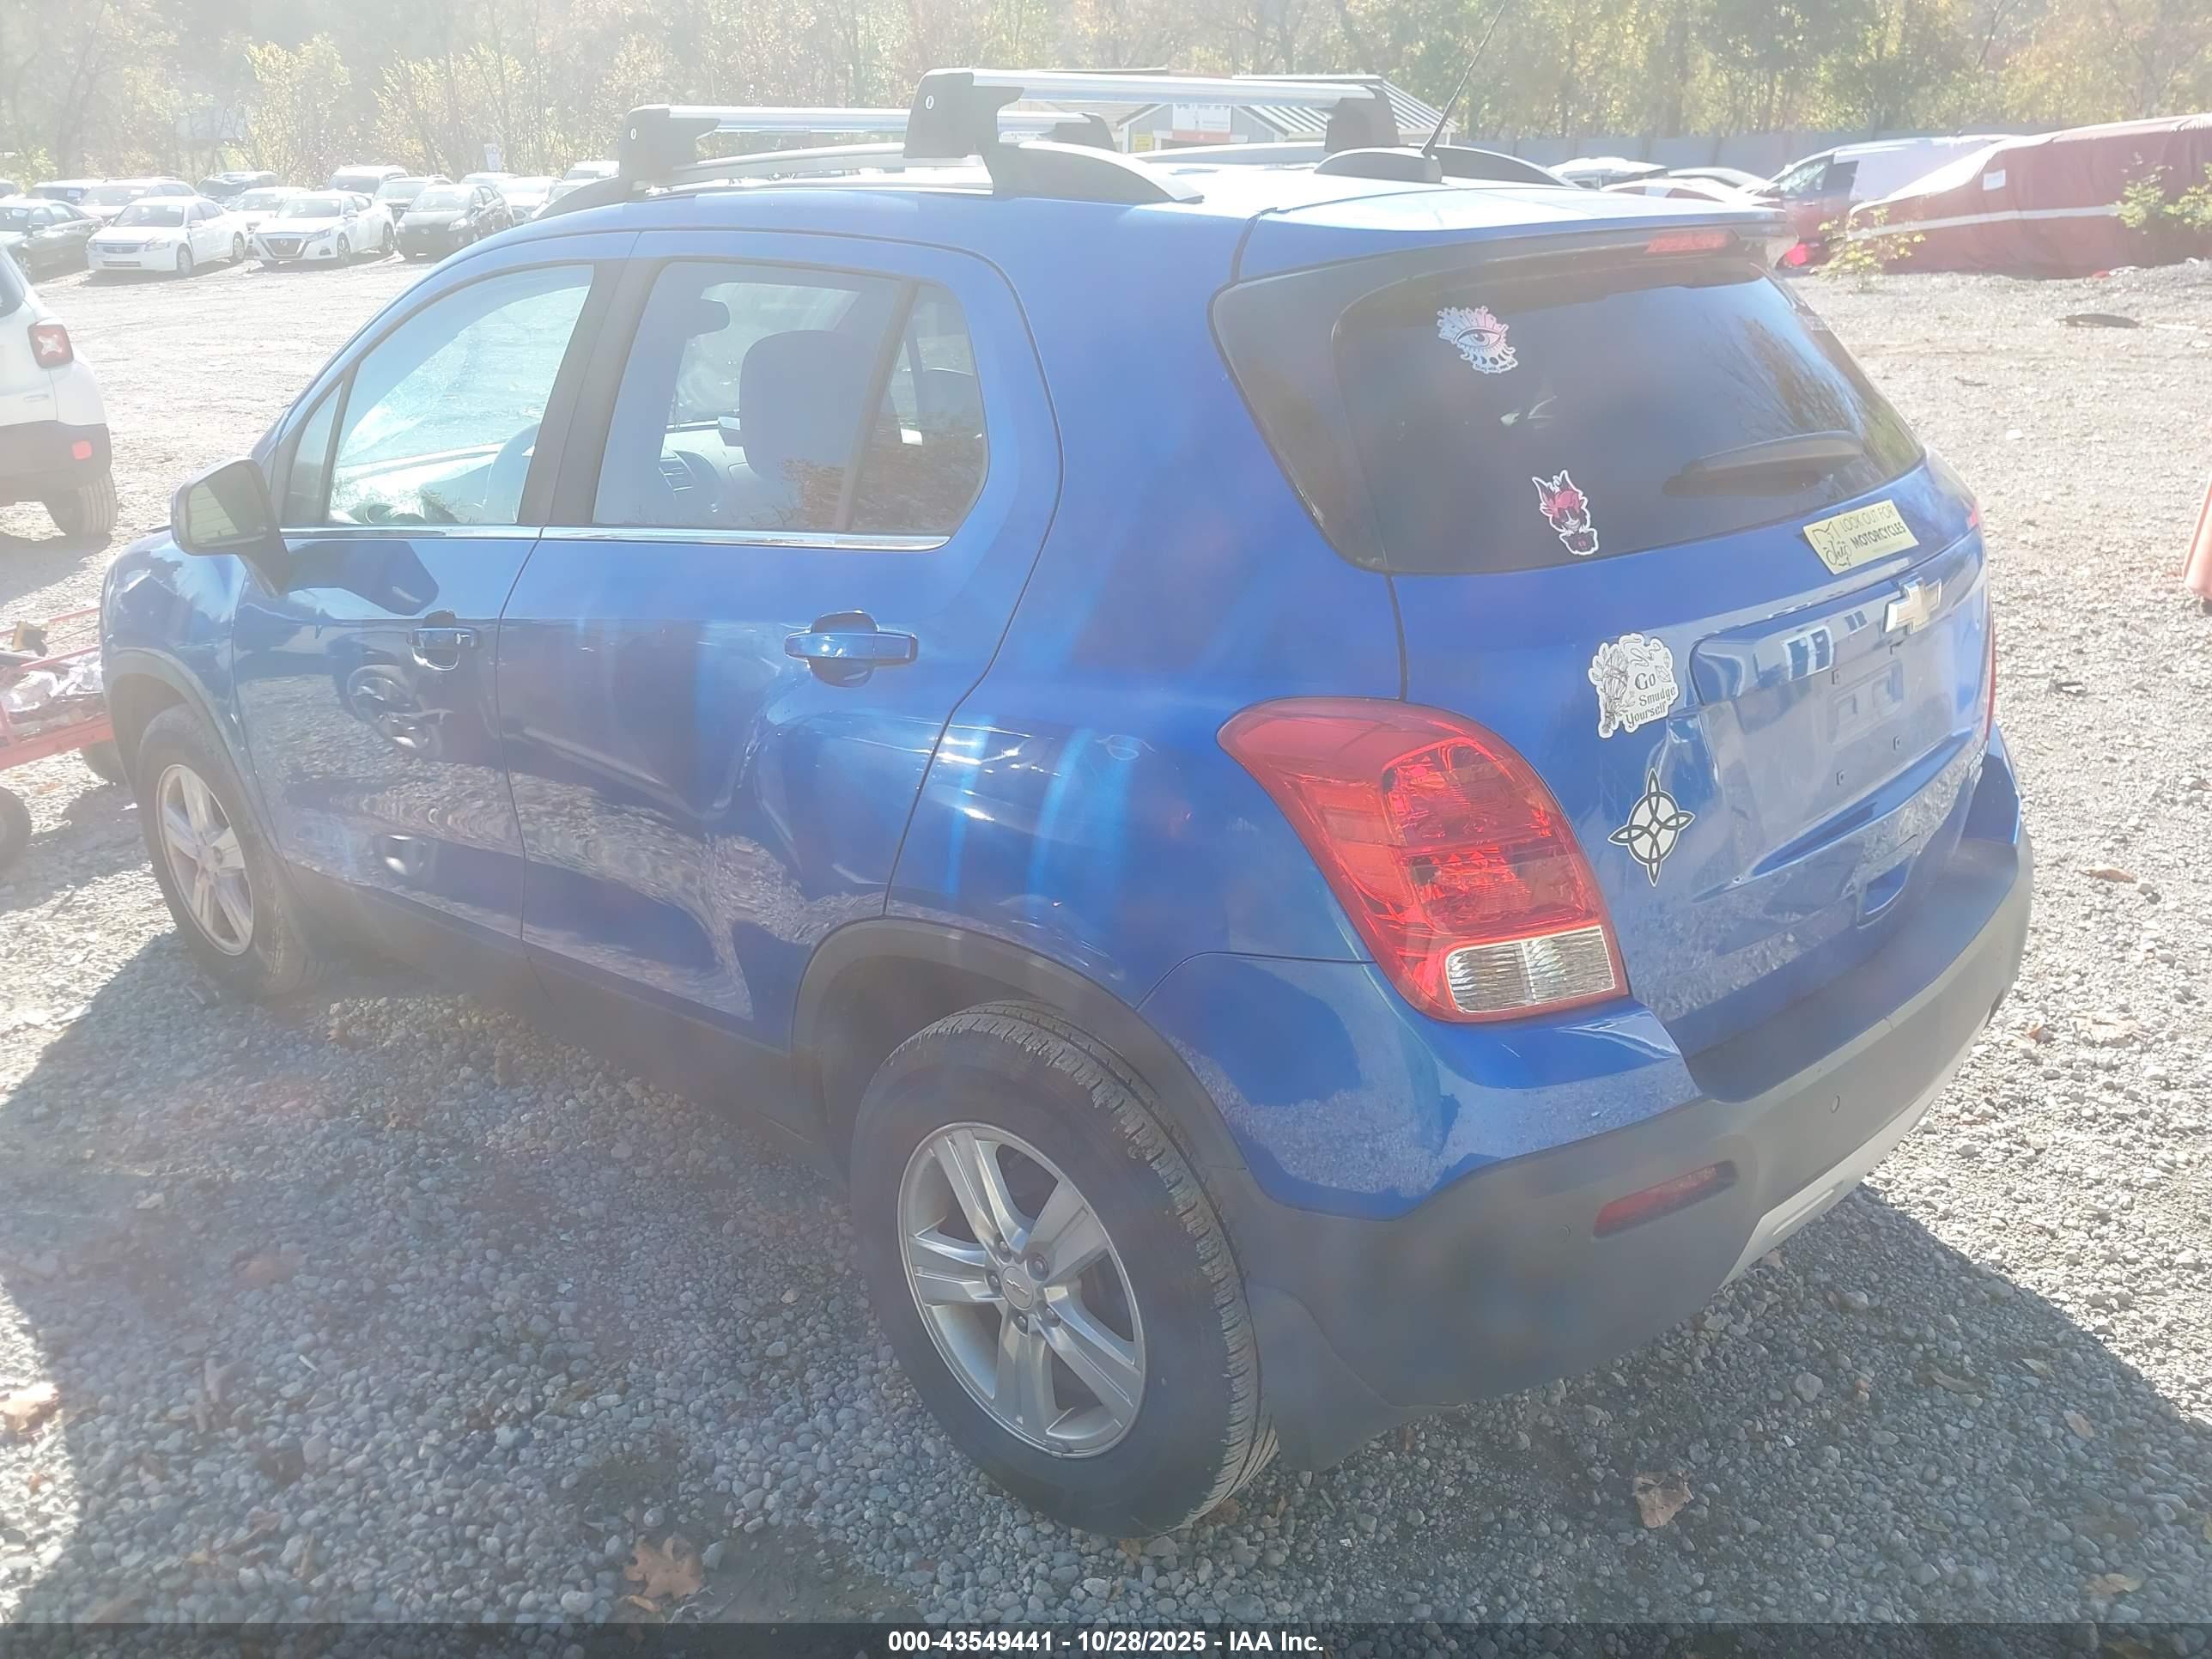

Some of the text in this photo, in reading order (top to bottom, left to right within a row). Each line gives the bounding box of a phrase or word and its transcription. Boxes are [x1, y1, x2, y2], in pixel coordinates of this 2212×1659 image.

[1840, 505, 1893, 532] LOOK OUT FOR
[1850, 522, 1906, 549] MOTORCYCLES
[1634, 672, 1656, 690] Go
[1638, 686, 1675, 707] Smudge
[1626, 701, 1667, 728] Yourself
